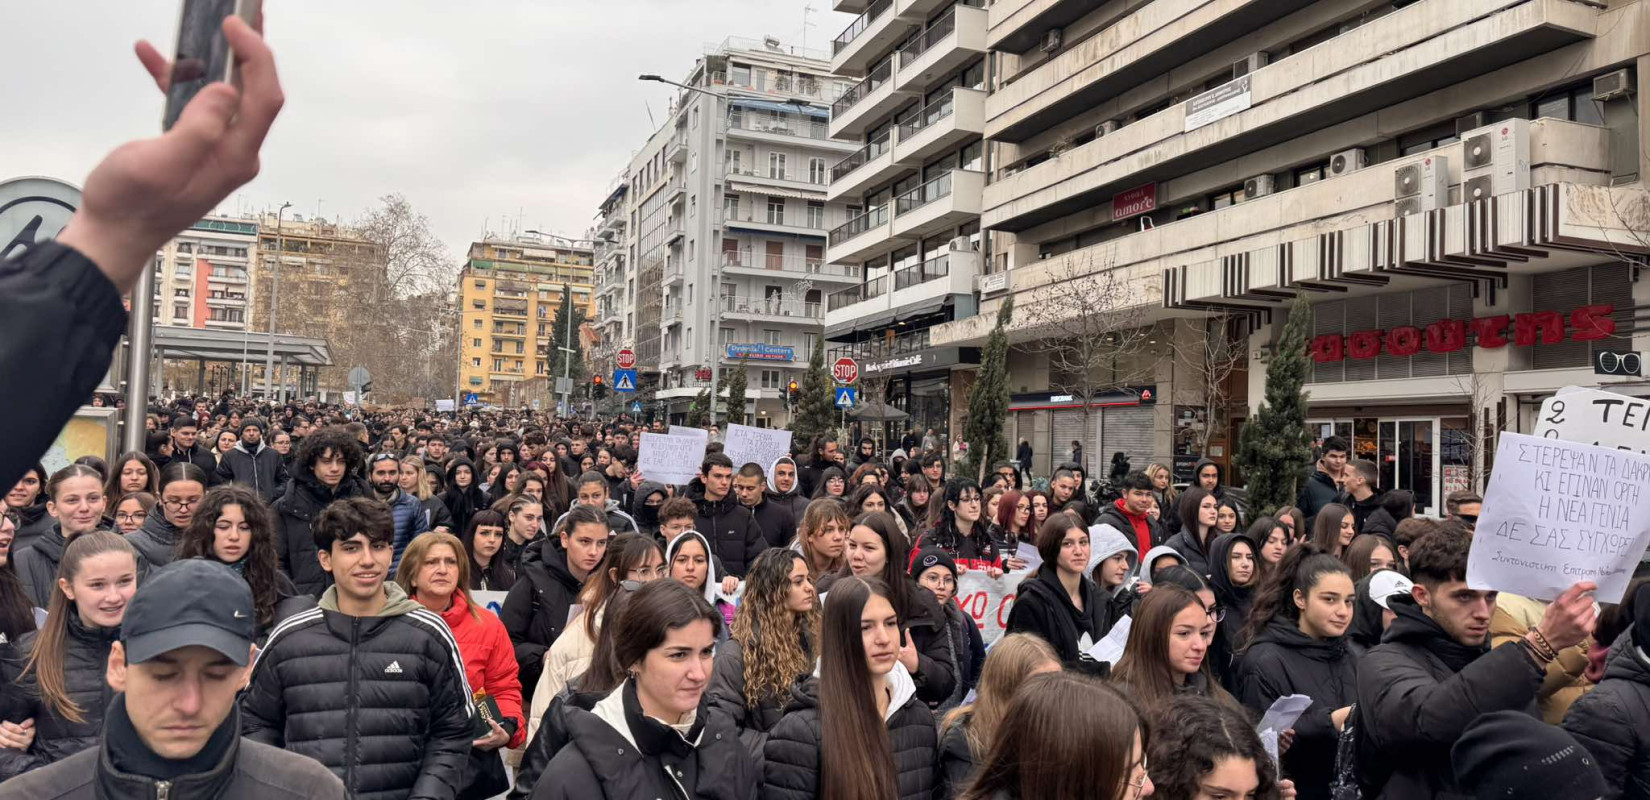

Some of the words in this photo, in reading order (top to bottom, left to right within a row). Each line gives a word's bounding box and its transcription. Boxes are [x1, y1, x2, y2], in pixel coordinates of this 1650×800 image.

[616, 351, 635, 365] STOP
[834, 364, 856, 378] STOP
[1545, 400, 1565, 424] 2
[1592, 399, 1650, 431] ΤΕ
[1518, 443, 1598, 474] ΣΤΕΡΕΨΑΝ
[1605, 454, 1616, 476] ΤΑ
[1534, 469, 1552, 492] ΚΙ
[1558, 472, 1609, 500] ΕΓΙΝΑΝ
[1613, 481, 1640, 506] ΟΡΓΗ
[1538, 495, 1550, 519] Η
[1556, 497, 1586, 523] ΝΕΑ
[1590, 502, 1630, 531] ΓΕΝΙΑ
[1496, 520, 1527, 542] ΔΕ
[1529, 524, 1572, 550] ΣΑΣ
